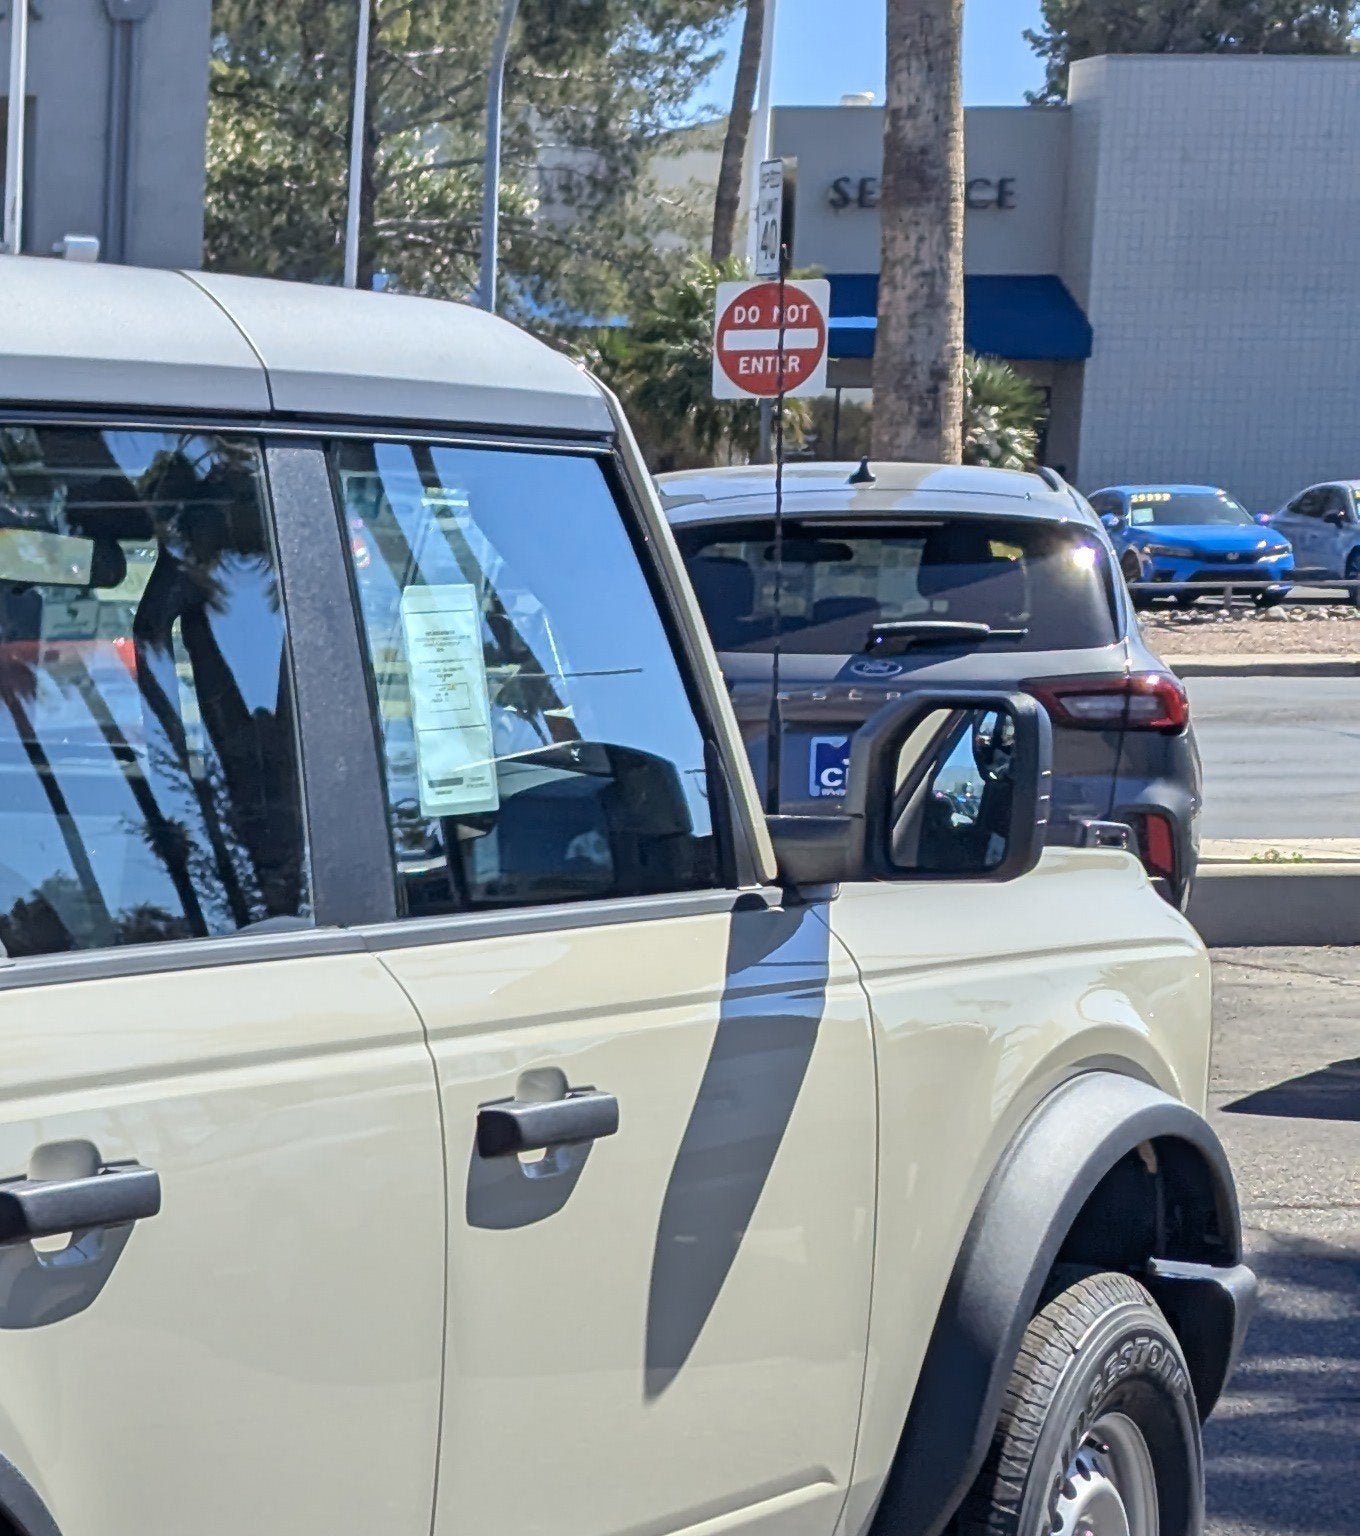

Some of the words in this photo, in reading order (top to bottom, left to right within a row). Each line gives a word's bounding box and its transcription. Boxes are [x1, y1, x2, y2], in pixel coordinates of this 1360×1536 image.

[829, 177, 1017, 210] SECE
[760, 218, 778, 260] 40
[733, 305, 761, 324] DO
[771, 304, 811, 324] NOT
